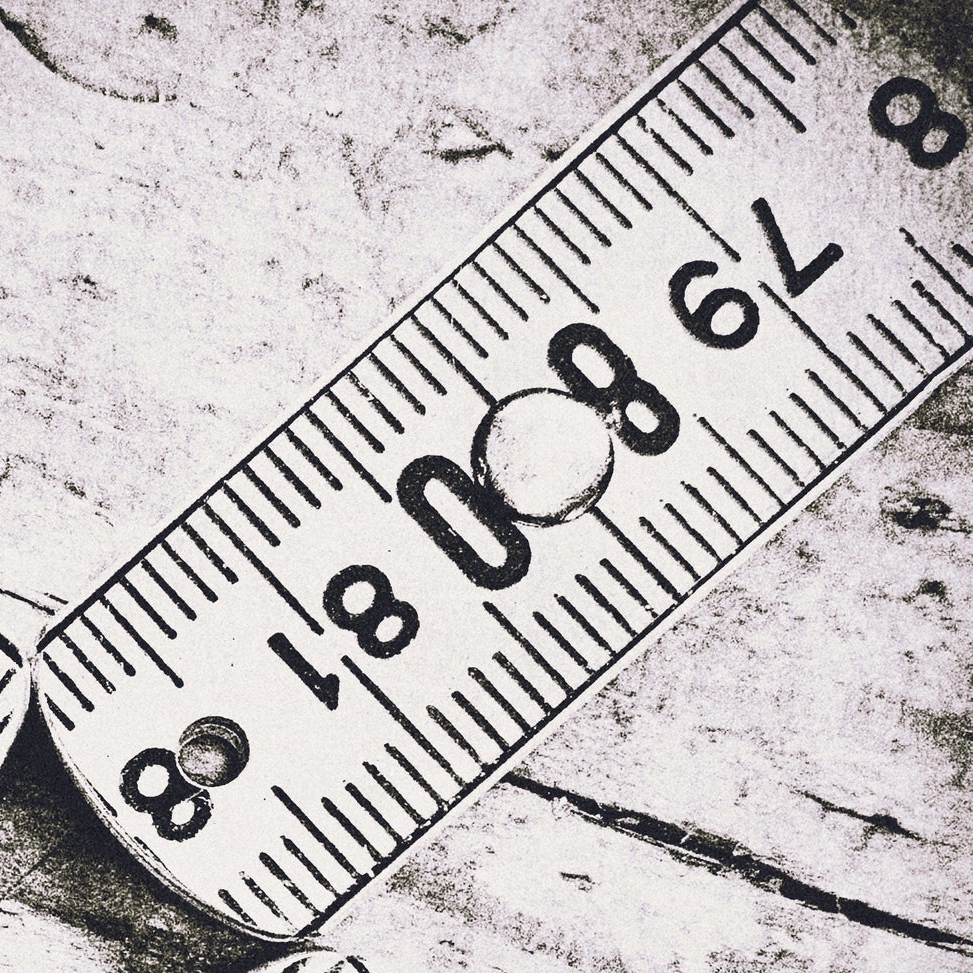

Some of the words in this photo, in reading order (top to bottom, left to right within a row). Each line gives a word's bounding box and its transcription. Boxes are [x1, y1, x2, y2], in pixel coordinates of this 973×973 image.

[868, 74, 968, 170] 8
[669, 197, 845, 349] 79
[395, 323, 681, 591] 80
[267, 564, 421, 711] 81
[119, 748, 211, 842] 8
